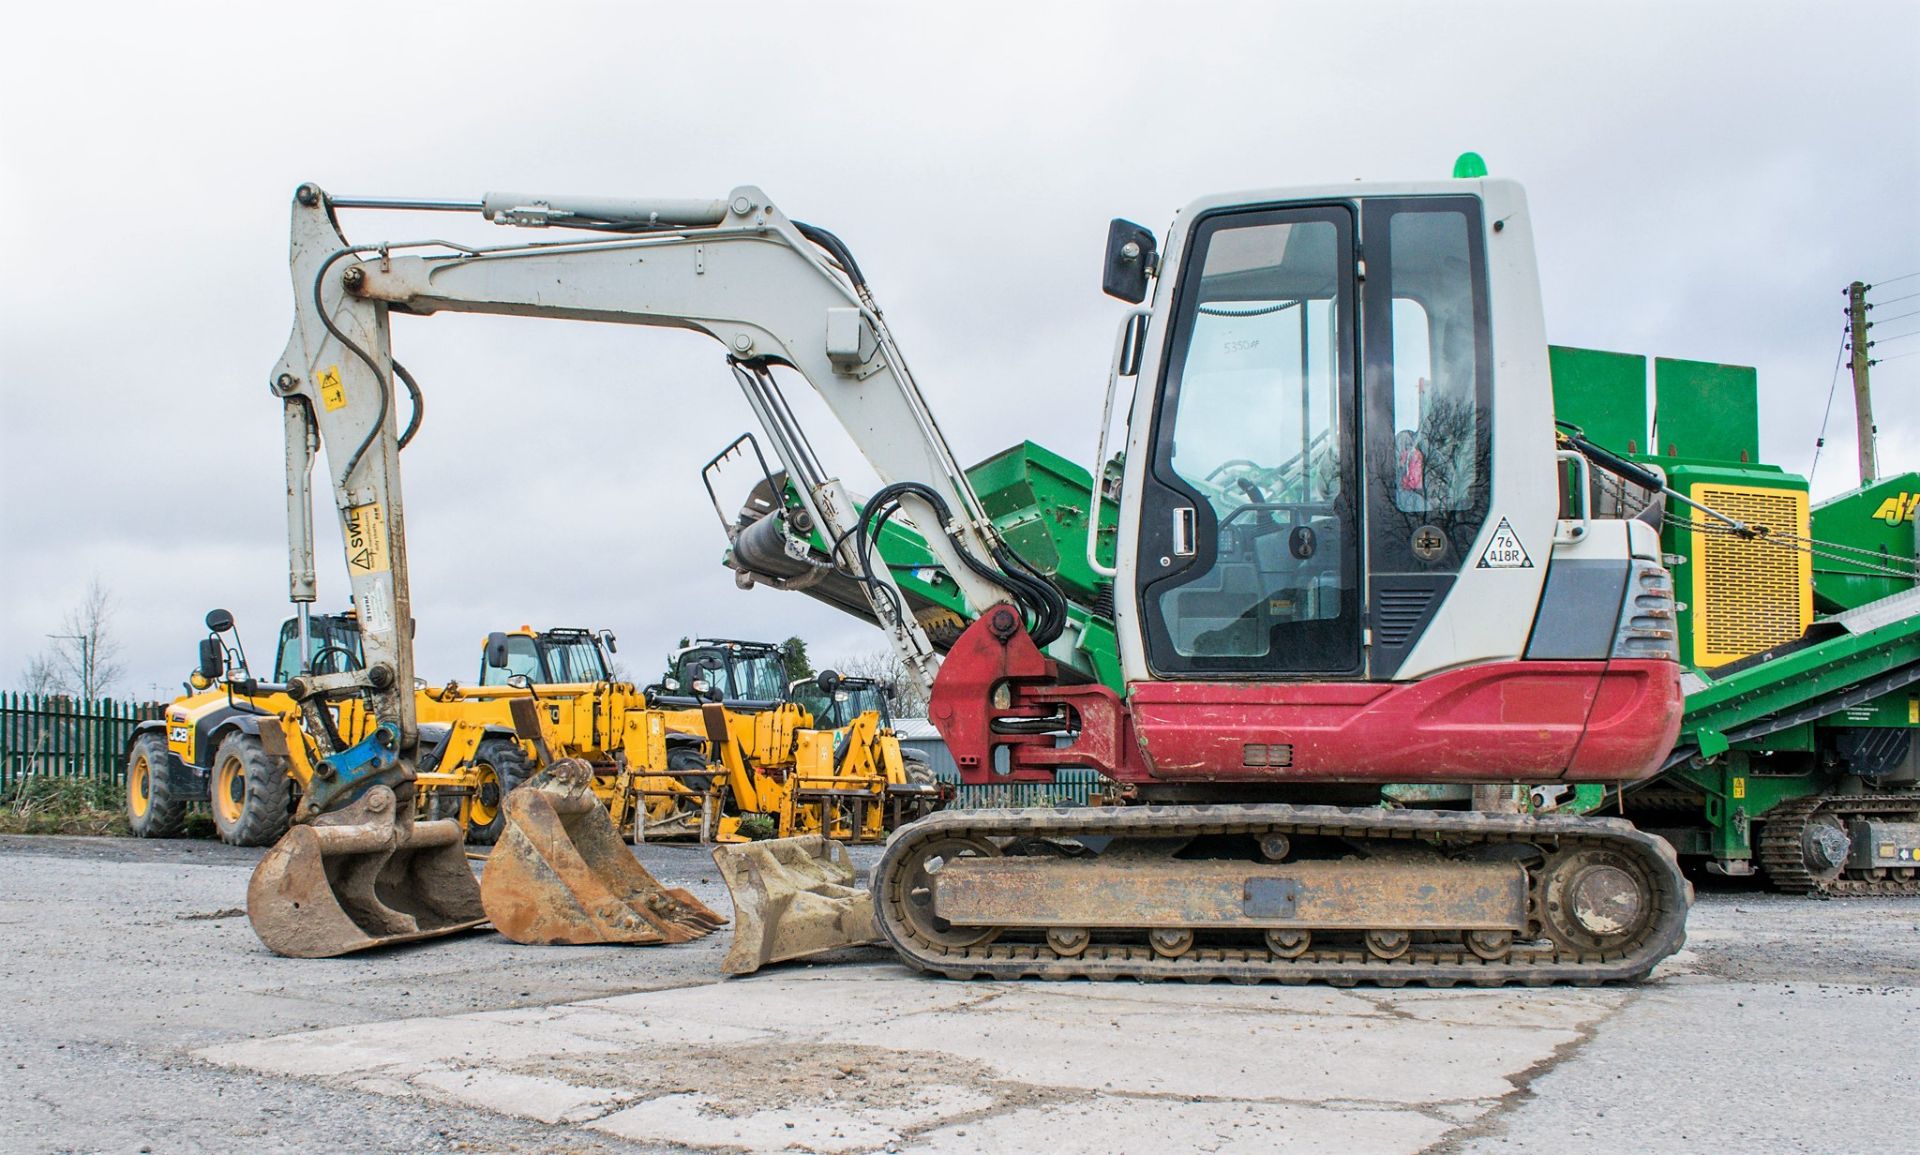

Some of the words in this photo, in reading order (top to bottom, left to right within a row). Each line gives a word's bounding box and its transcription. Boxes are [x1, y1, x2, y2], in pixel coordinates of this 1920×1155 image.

[350, 511, 363, 548] SWL
[1497, 536, 1513, 548] 76
[1489, 550, 1520, 562] A18R
[169, 727, 188, 742] JCB
